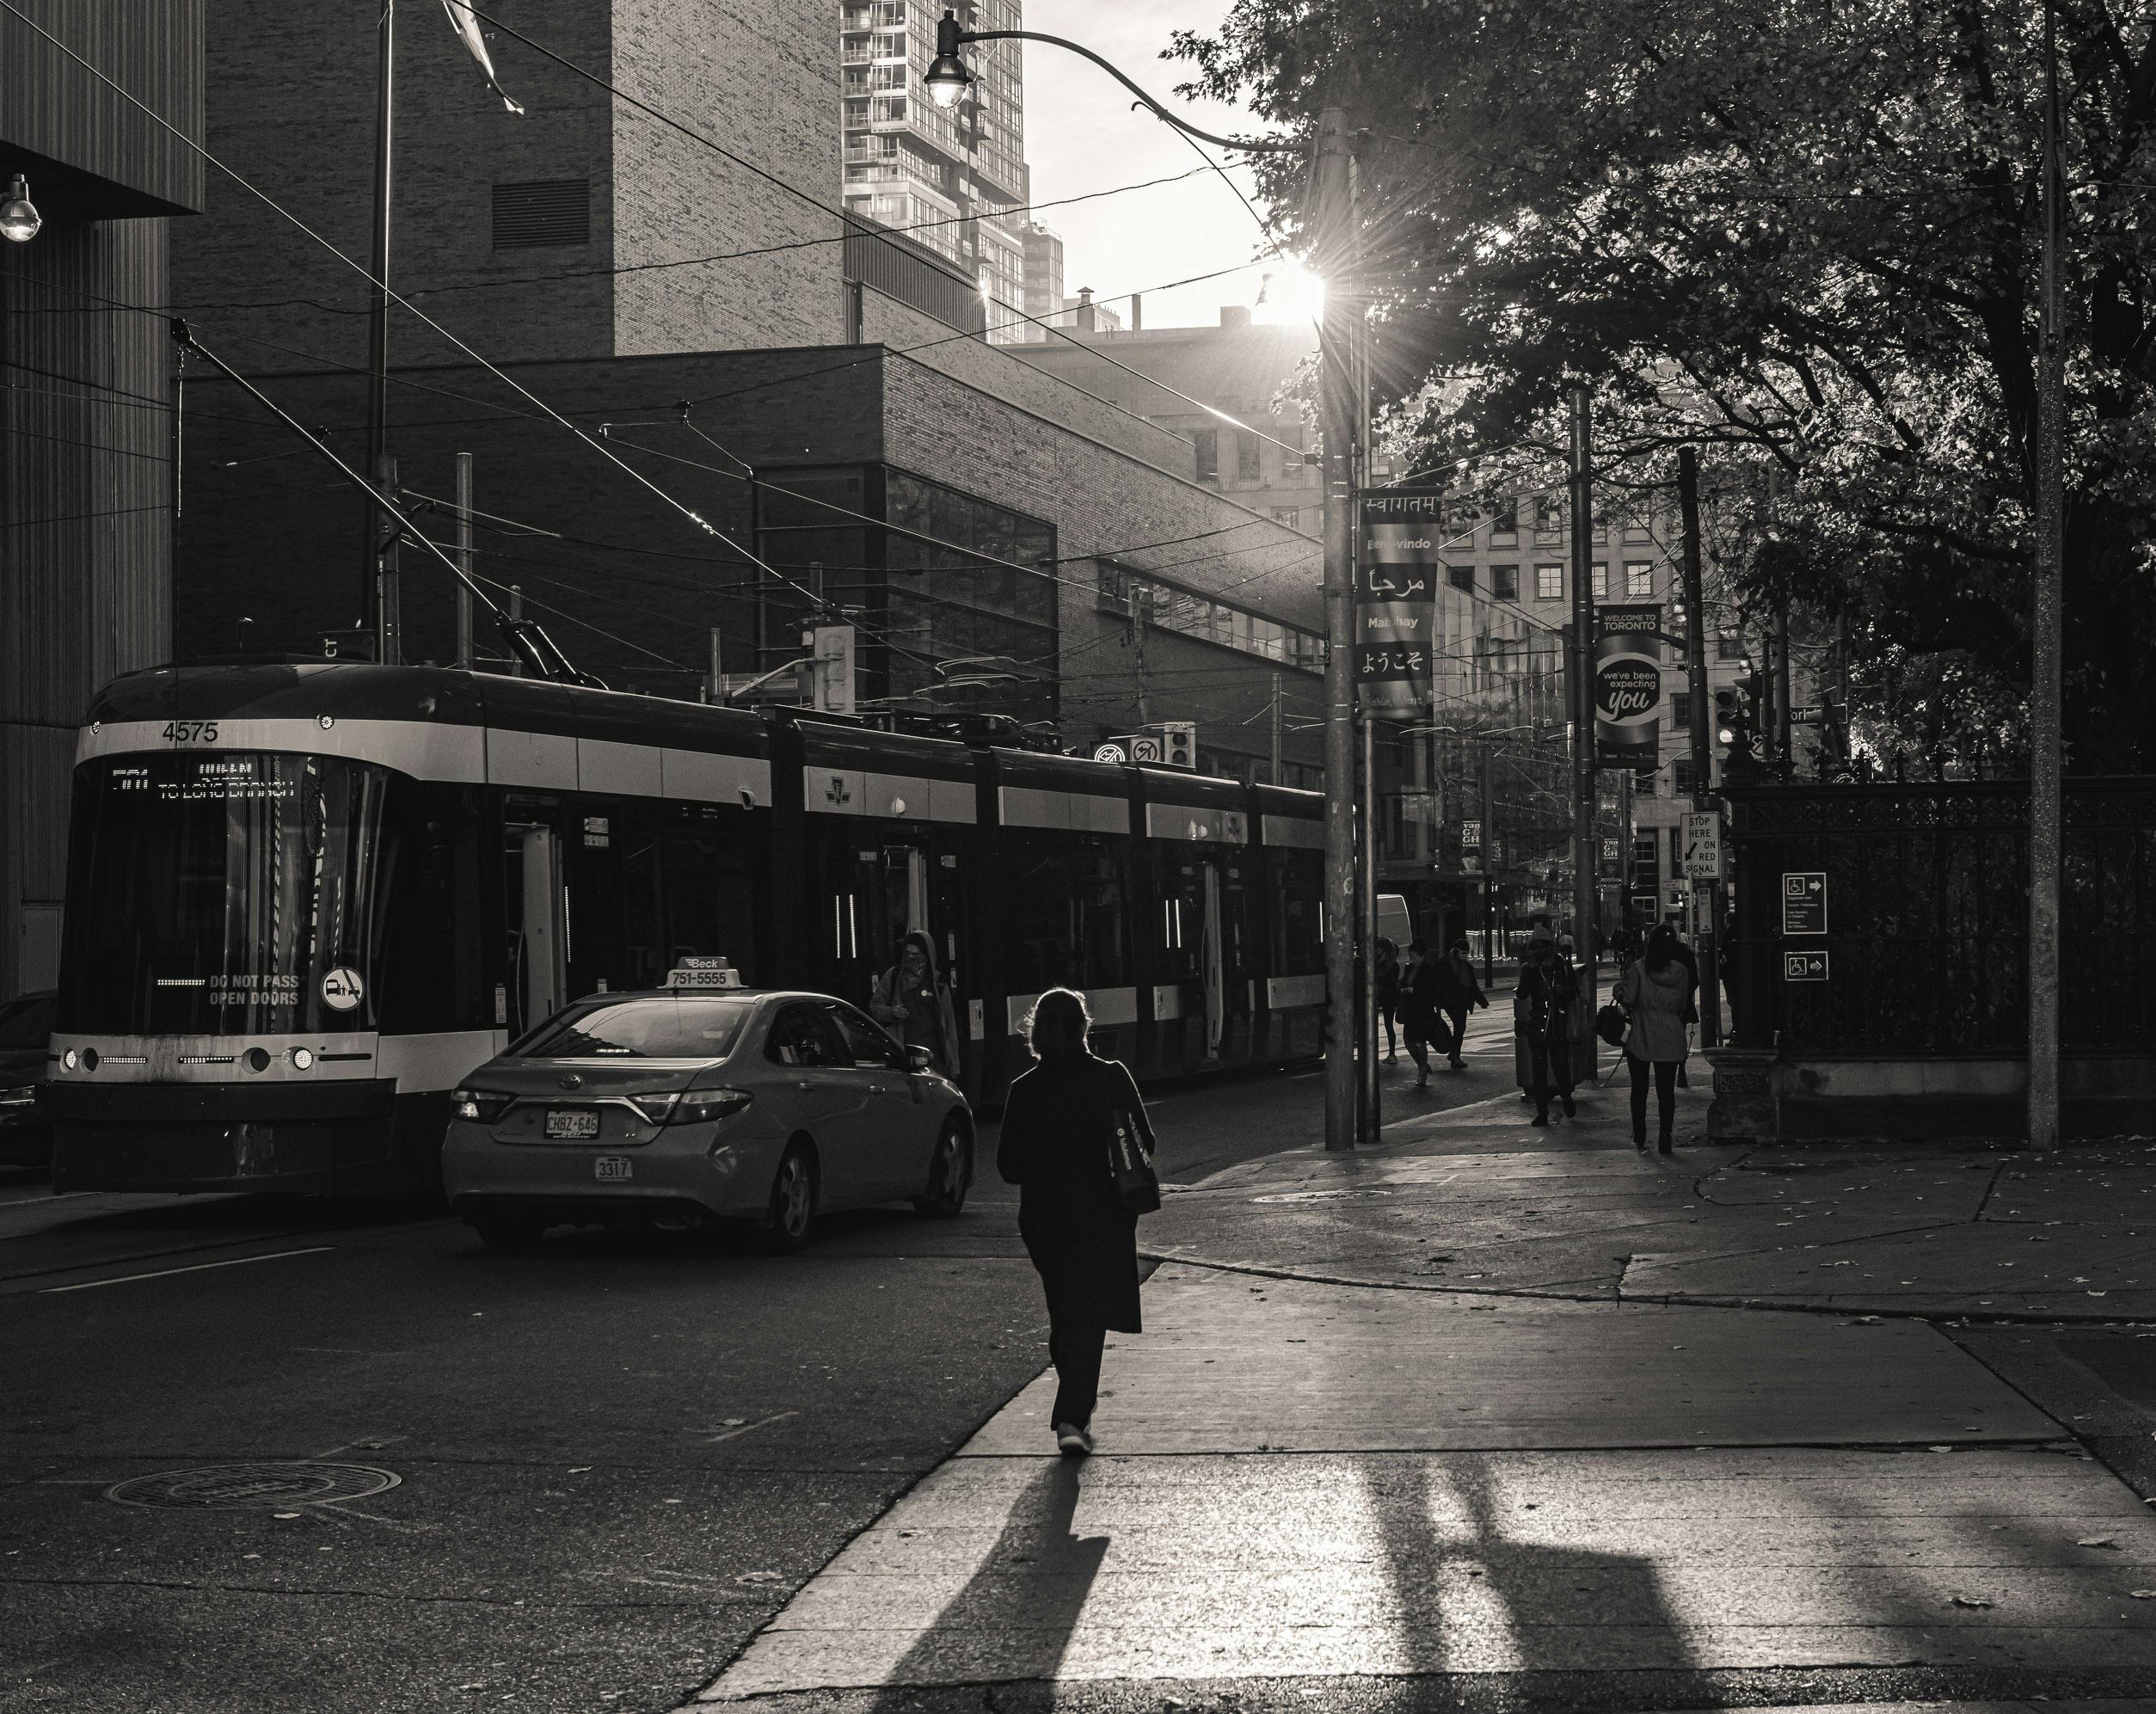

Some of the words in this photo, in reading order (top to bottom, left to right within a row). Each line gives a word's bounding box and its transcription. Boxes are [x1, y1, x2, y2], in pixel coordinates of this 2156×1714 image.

[1367, 538, 1431, 550] Bevindo
[1368, 616, 1419, 629] Mabhay
[1604, 621, 1656, 631] TORONTO
[1361, 651, 1423, 673] ようこそ
[1632, 671, 1656, 680] been
[1610, 679, 1656, 690] expecting
[1608, 690, 1649, 720] you
[163, 722, 218, 742] 4575
[1689, 817, 1711, 826] STOP
[1689, 829, 1711, 838] HERE
[1699, 852, 1716, 861] RED
[1686, 864, 1715, 874] SIGNAL
[685, 958, 718, 968] Beck
[210, 974, 228, 988] DO
[232, 974, 258, 988] NOT
[263, 974, 299, 988] PASS
[673, 972, 727, 985] 751-5555
[209, 992, 245, 1005] OPEN
[250, 992, 299, 1005] DOORS
[599, 1162, 628, 1176] 3317
